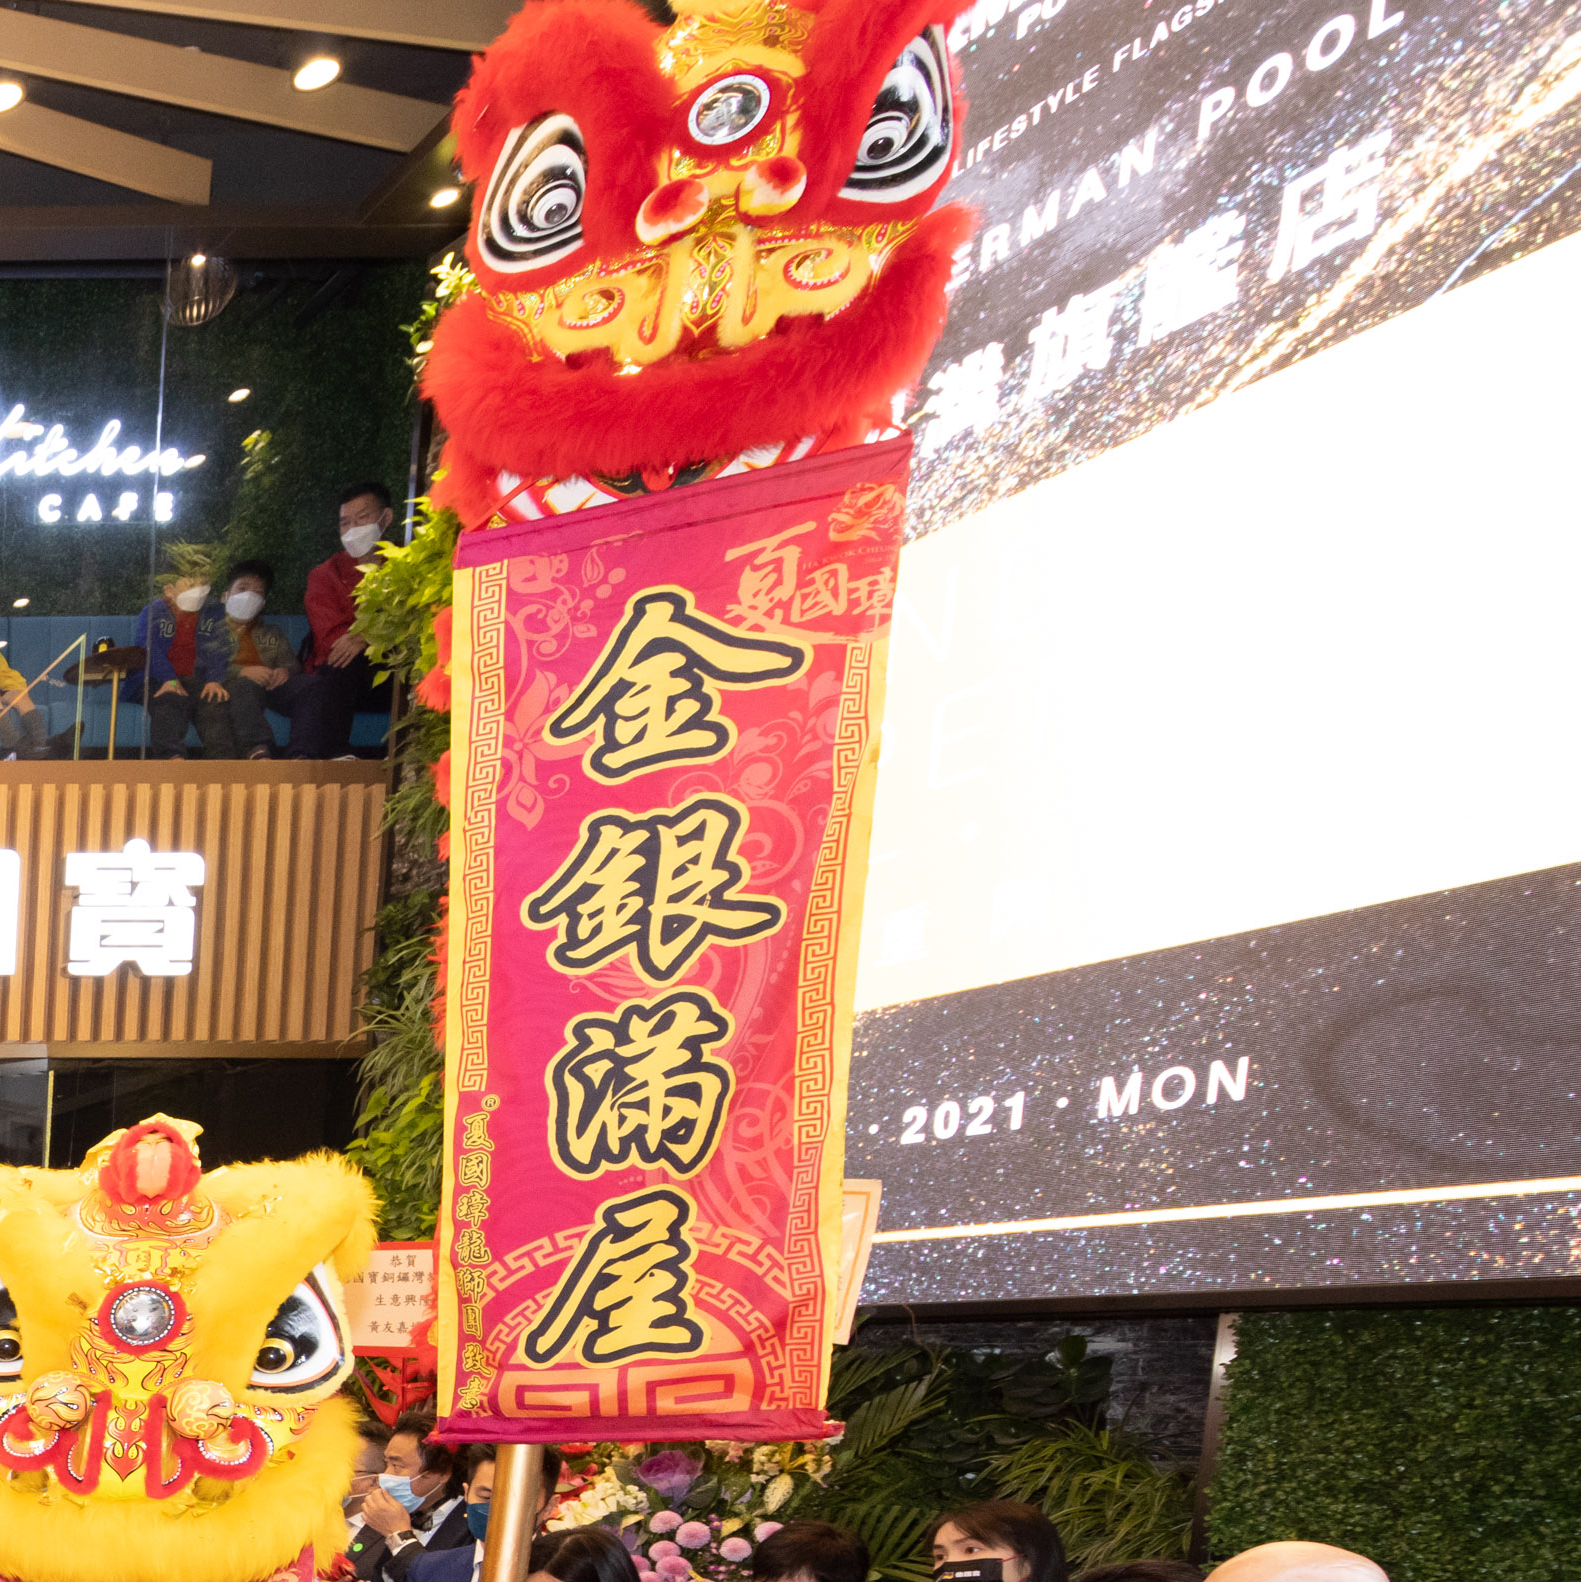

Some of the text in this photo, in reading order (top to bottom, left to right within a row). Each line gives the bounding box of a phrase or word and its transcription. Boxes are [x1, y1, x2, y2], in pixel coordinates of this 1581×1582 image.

[951, 64, 1100, 179] LIFESTYLE
[1113, 0, 1225, 73] FLAGS
[945, 0, 1405, 292] ERMAN POOL
[37, 492, 175, 523] CAFE
[520, 585, 814, 1368] 金銀滿屋
[899, 1056, 1251, 1145] 2021 MON
[343, 1271, 433, 1284] 國寶銅鑼灣
[368, 1321, 419, 1334] 黃友嘉
